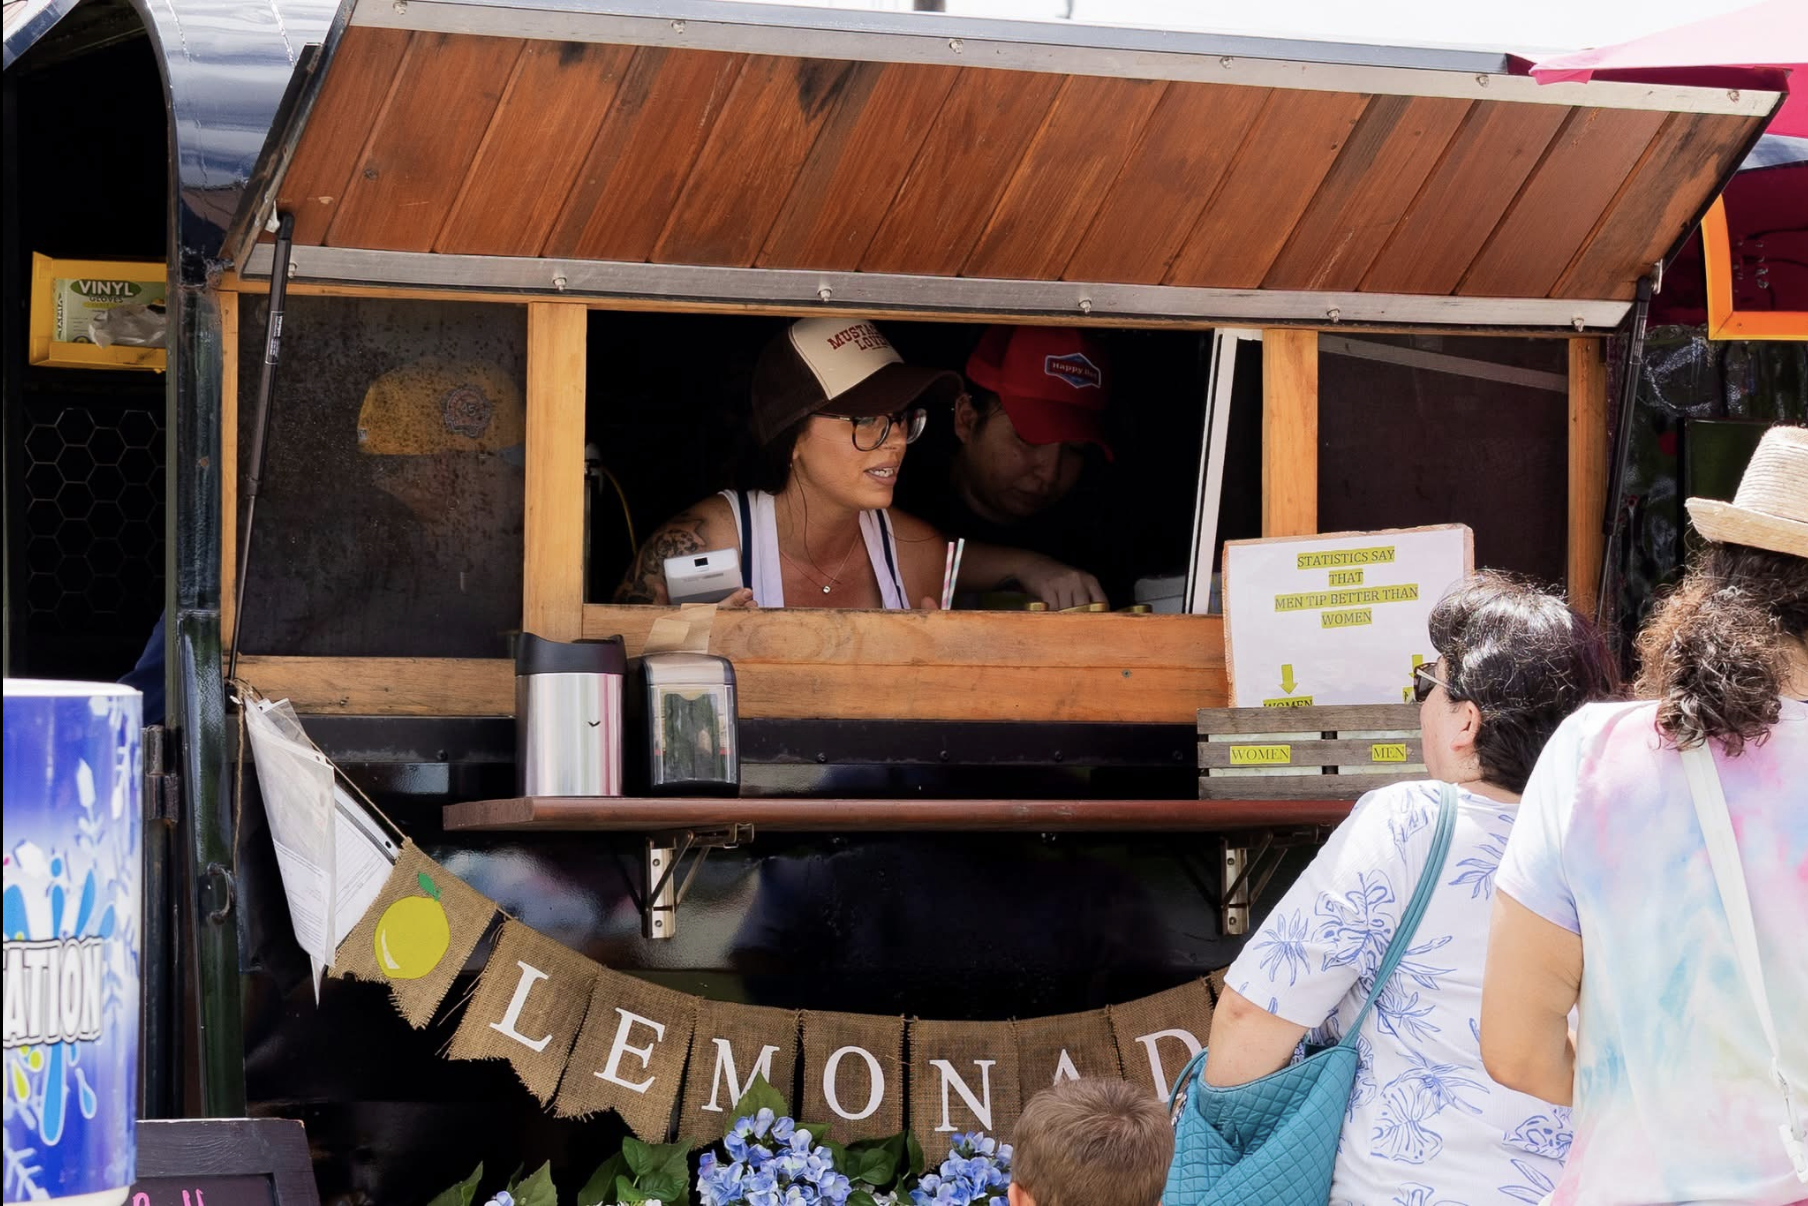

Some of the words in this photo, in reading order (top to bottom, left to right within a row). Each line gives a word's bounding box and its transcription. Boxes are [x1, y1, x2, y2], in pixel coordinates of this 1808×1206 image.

[79, 280, 134, 296] VINYL
[89, 295, 124, 304] GLOVES
[1052, 362, 1084, 374] Happy
[1297, 552, 1368, 567] STATISTICS
[1371, 549, 1395, 561] SAY
[1329, 571, 1364, 584] THAT
[1275, 596, 1304, 610] MEN
[1306, 595, 1327, 607] TIP
[1330, 590, 1380, 604] BETTER
[1382, 587, 1419, 600] THAN
[1321, 611, 1372, 625] WOMEN
[1231, 748, 1289, 760] WOMEN
[1373, 747, 1405, 759] MEN
[3, 938, 102, 1047] ATION
